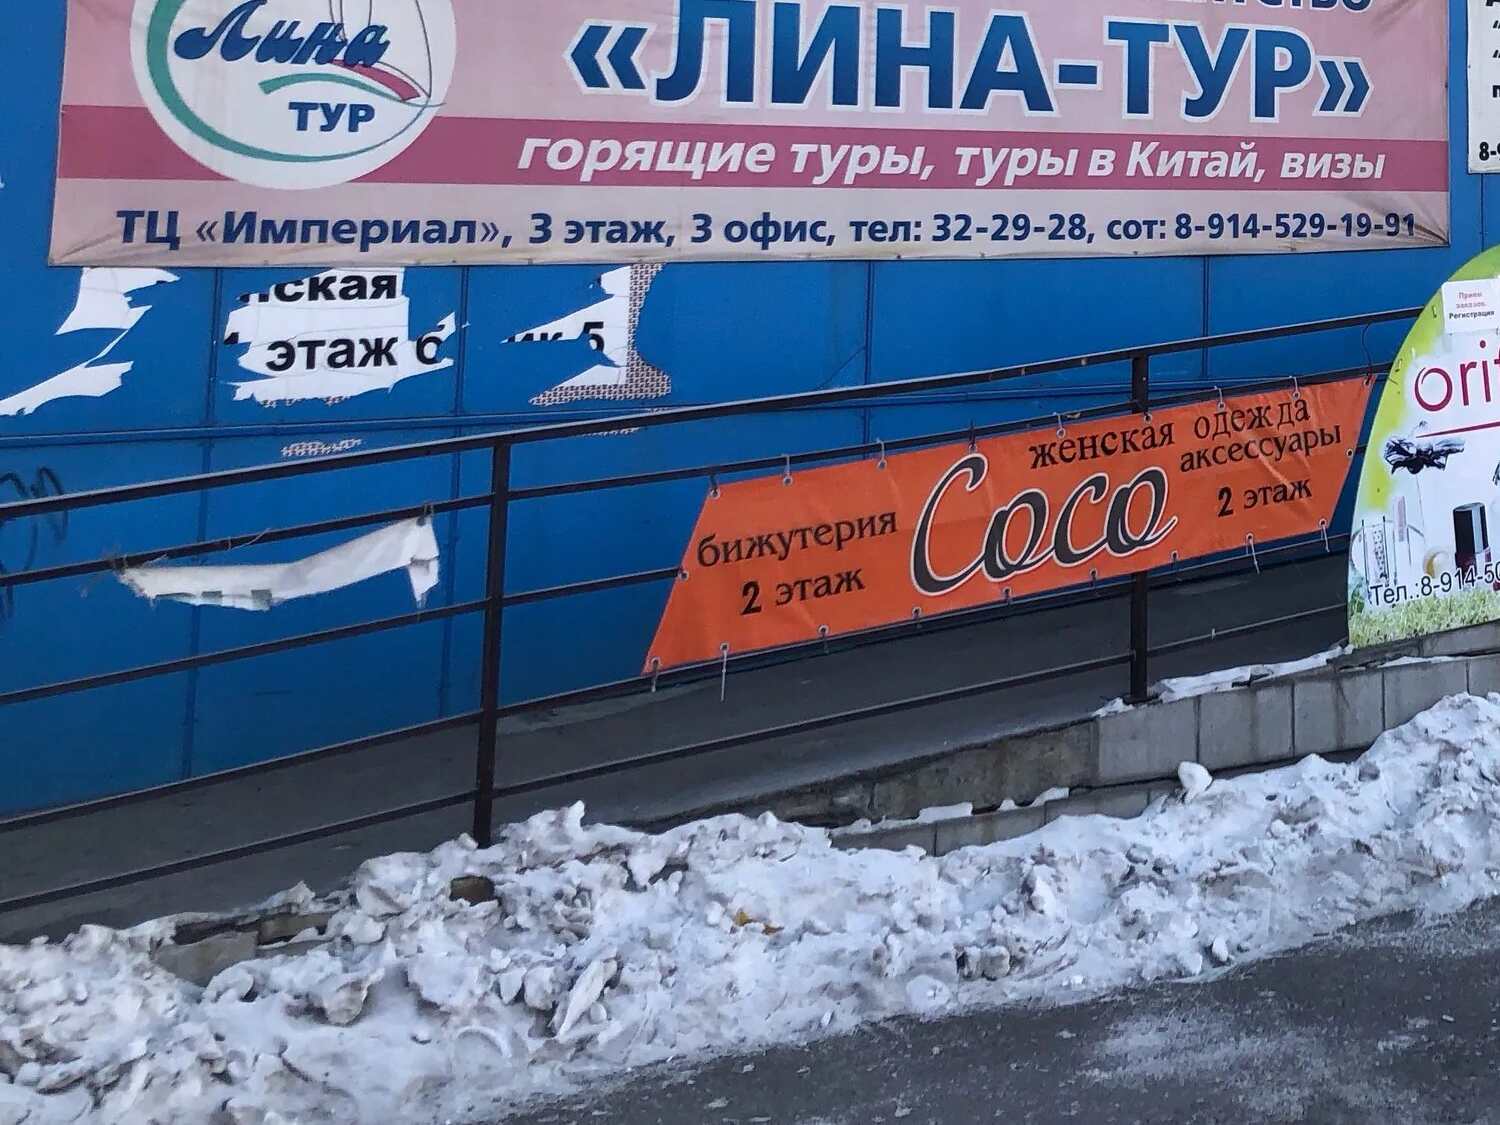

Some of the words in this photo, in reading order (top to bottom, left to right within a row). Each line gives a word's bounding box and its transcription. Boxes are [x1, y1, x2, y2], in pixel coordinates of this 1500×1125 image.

[289, 101, 376, 133] ТУР
[517, 137, 772, 181] горящие
[791, 142, 935, 181] туры,
[956, 145, 1077, 180] туры
[1089, 149, 1116, 177] в
[1131, 141, 1265, 183] Китай,
[1280, 150, 1386, 180] визы
[117, 209, 181, 251] ТЦ
[196, 211, 511, 248] «Империал»,
[528, 213, 552, 244] 3
[564, 219, 676, 249] этаж,
[691, 214, 713, 244] 3
[724, 212, 834, 248] офис,
[851, 220, 922, 243] тел:
[933, 213, 1096, 246] 32-29-28,
[1106, 215, 1166, 242] сот:
[1175, 212, 1416, 242] 8-914-529-19-91
[1449, 310, 1494, 319] Регистрация
[266, 336, 397, 370] этаж
[1029, 419, 1174, 471] женская
[1179, 422, 1342, 475] аксессуары
[1217, 487, 1233, 518] 2
[1243, 477, 1312, 511] этаж
[698, 511, 898, 569] бижутерия
[740, 579, 762, 616] 2
[774, 566, 864, 607] этаж
